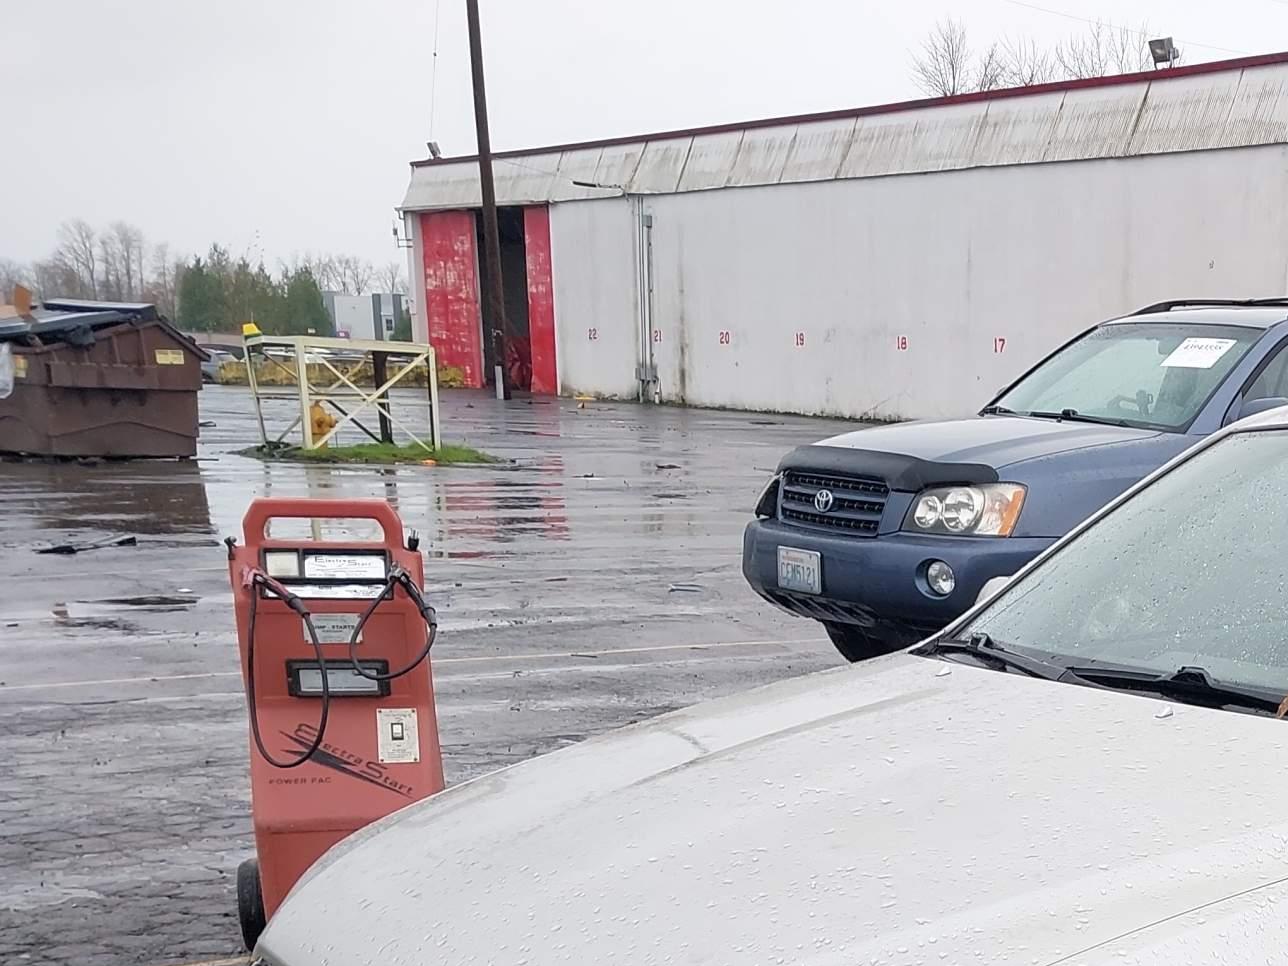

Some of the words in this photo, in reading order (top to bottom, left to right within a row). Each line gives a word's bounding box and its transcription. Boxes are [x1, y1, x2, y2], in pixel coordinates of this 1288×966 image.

[588, 328, 598, 340] 22
[653, 329, 662, 343] 21
[719, 331, 730, 345] 20
[795, 332, 805, 346] 19
[897, 336, 907, 350] 18
[993, 337, 1006, 353] 17
[360, 760, 414, 795] Start
